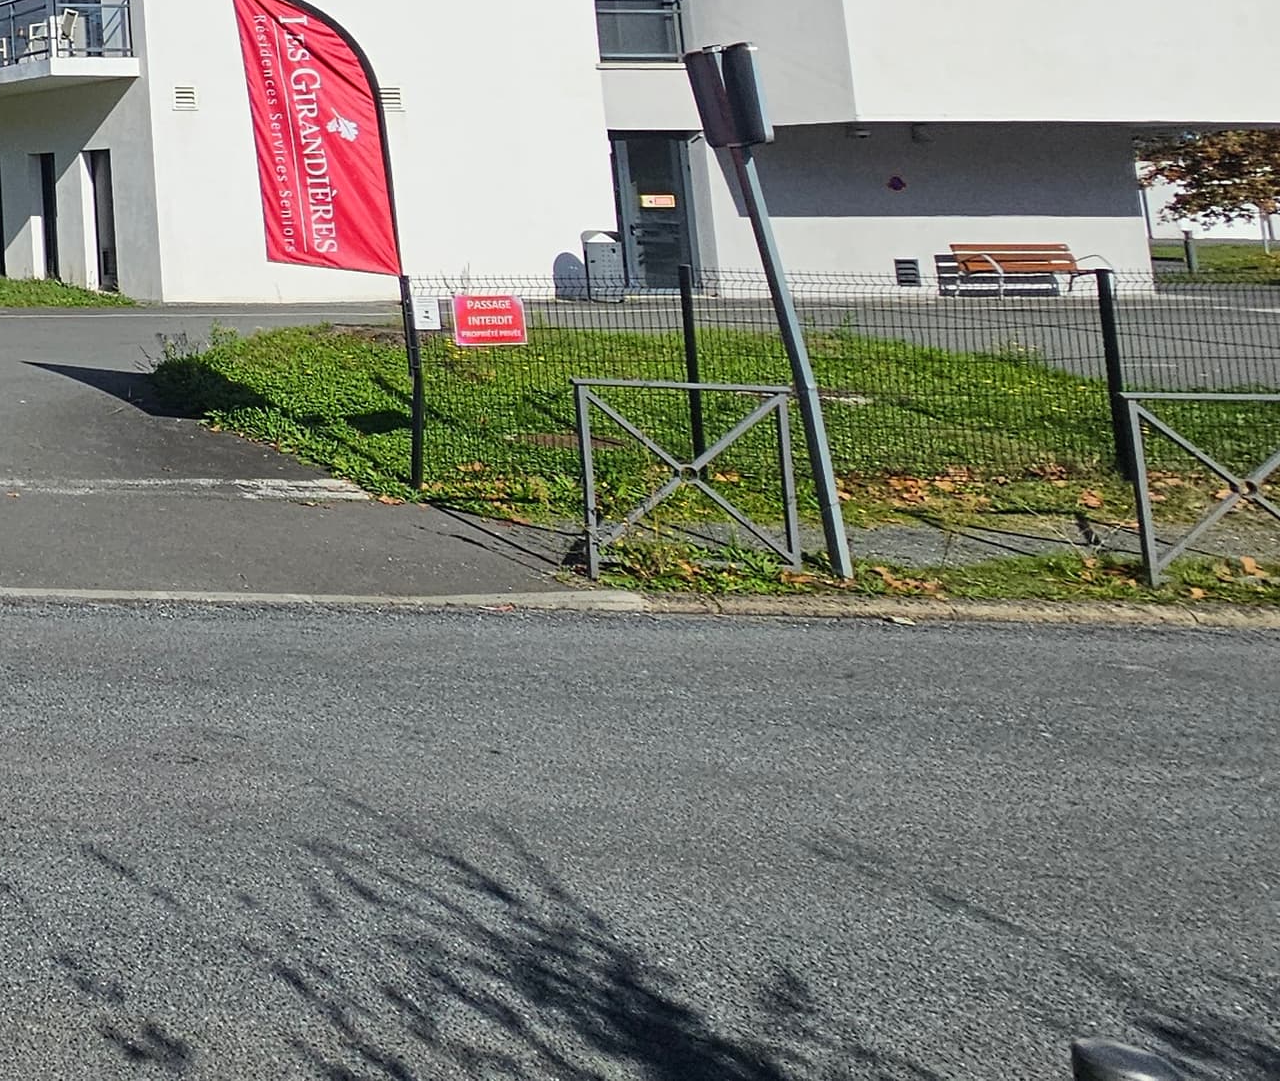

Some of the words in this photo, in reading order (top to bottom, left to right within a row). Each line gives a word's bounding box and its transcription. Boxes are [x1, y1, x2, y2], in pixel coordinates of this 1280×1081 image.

[253, 14, 278, 106] Résidences
[269, 112, 289, 183] Services
[279, 190, 297, 253] Seniors
[290, 67, 338, 254] GIRANDIÈRES
[466, 300, 512, 310] PASSAGE
[467, 315, 514, 326] INTERDIT
